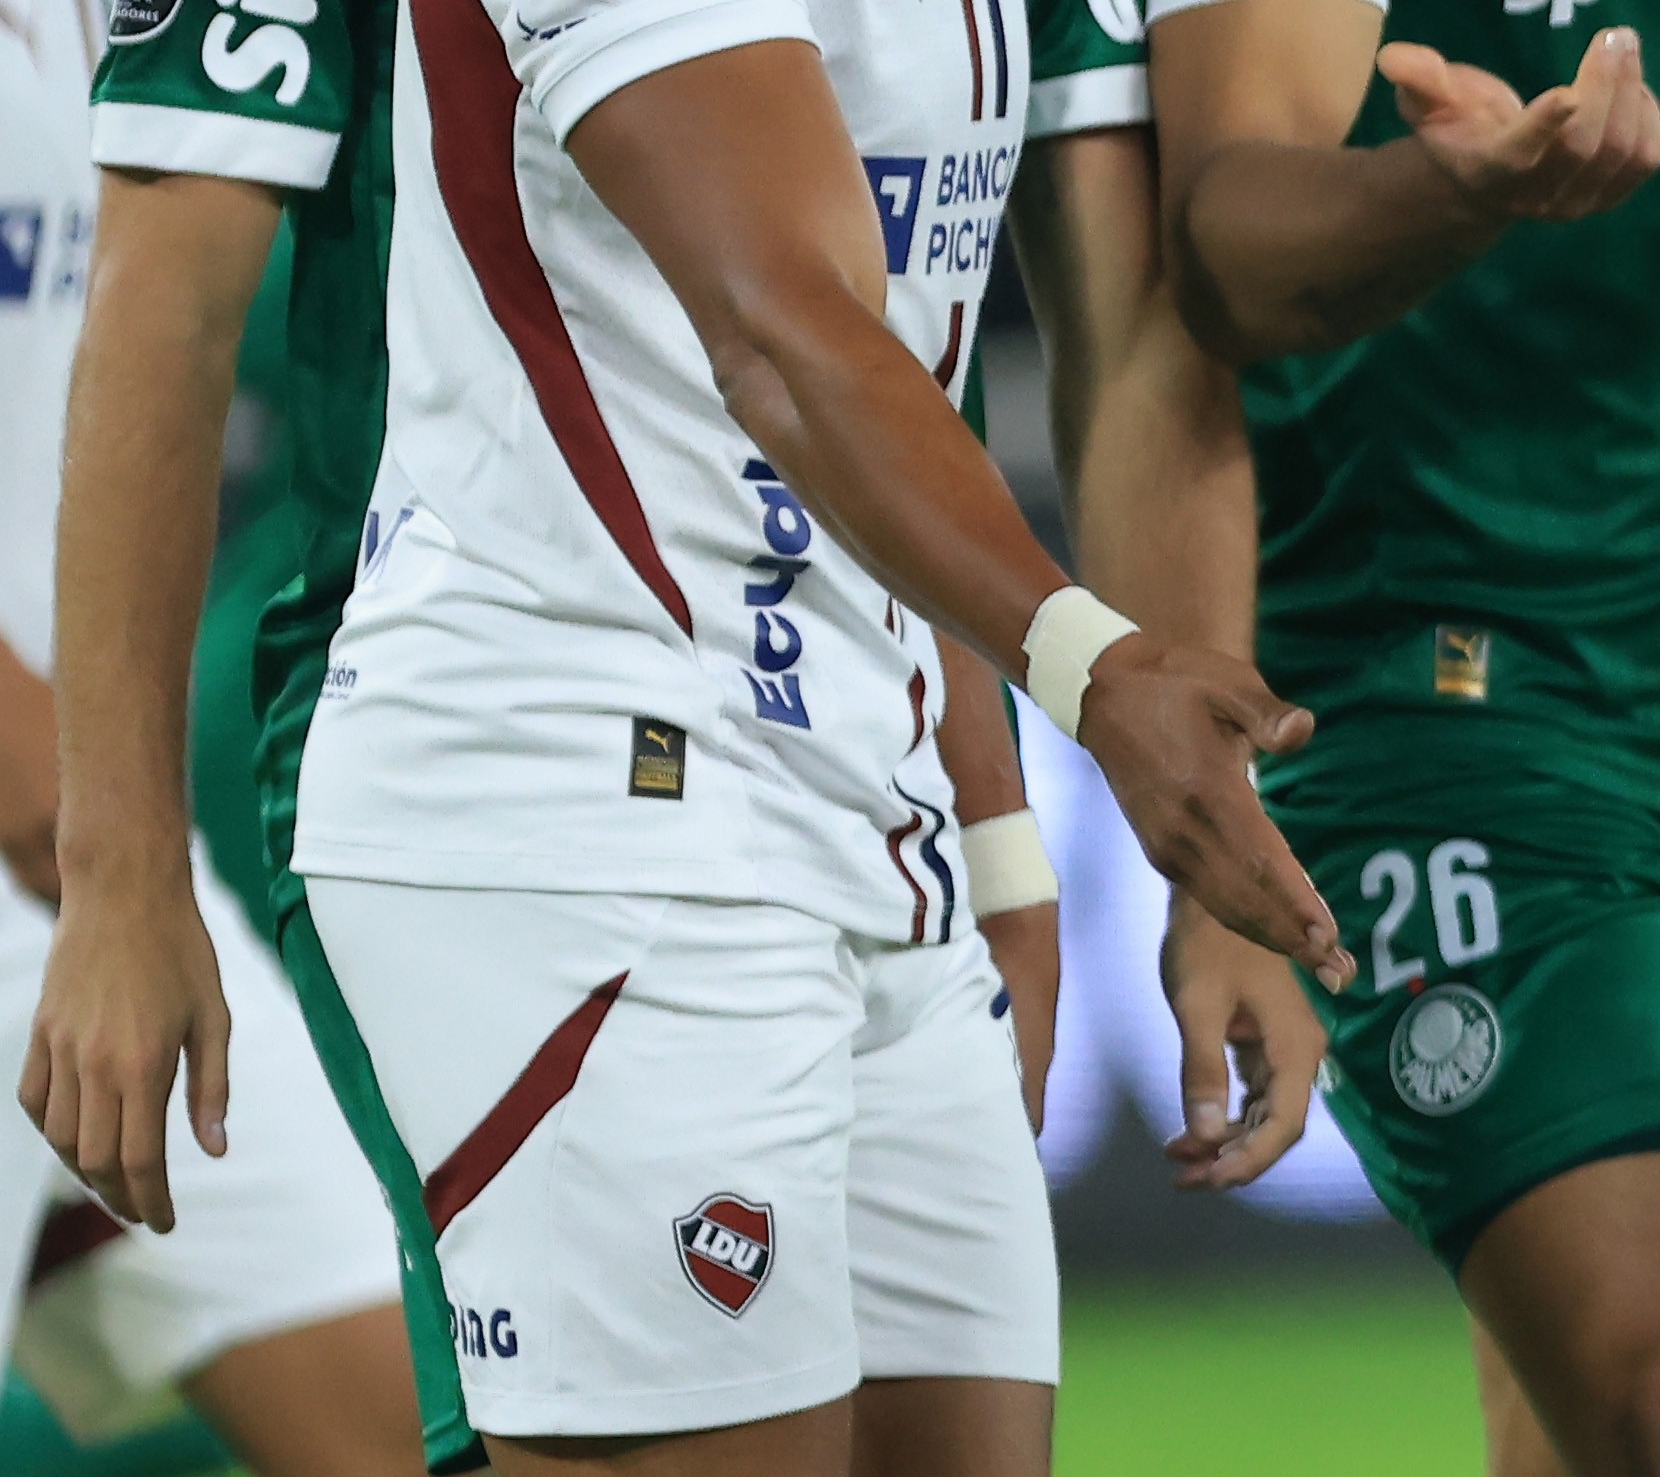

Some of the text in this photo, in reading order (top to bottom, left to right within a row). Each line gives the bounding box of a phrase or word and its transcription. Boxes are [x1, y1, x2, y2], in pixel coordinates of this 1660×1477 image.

[926, 217, 992, 275] PICH
[1360, 838, 1500, 994] 26
[691, 1221, 760, 1272] LDU
